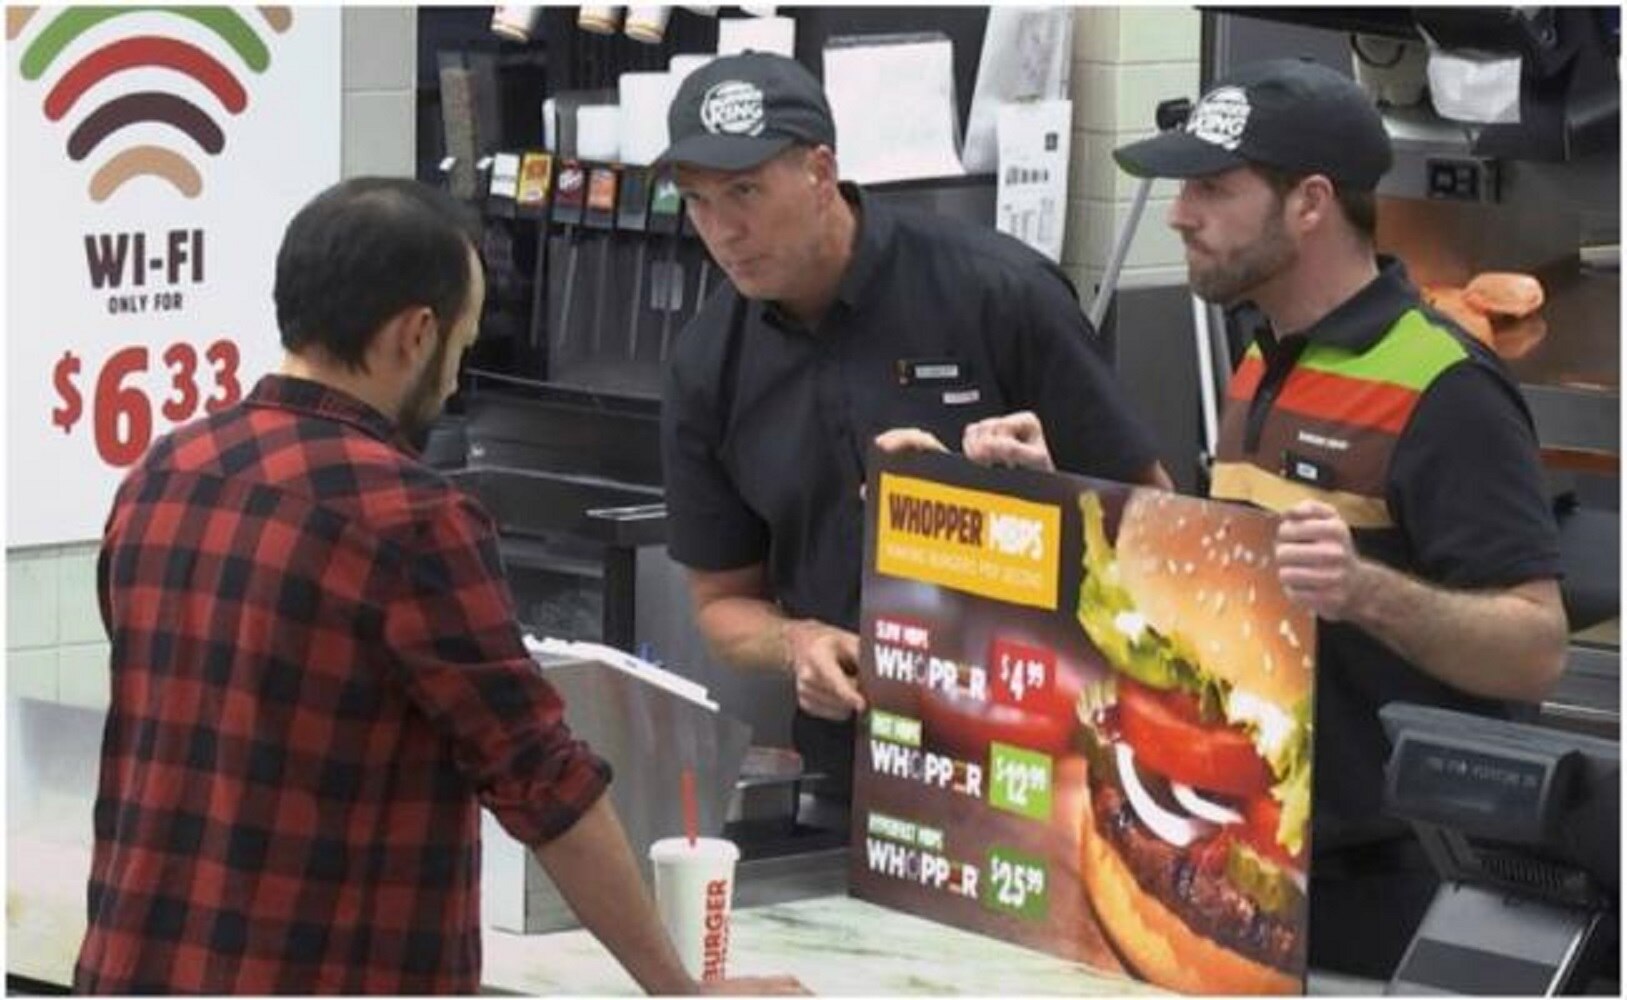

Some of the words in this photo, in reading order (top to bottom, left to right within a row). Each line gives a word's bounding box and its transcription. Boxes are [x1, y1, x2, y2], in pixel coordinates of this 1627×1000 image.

[84, 229, 203, 289] WI-FI
[108, 296, 147, 314] ONLY
[154, 292, 182, 310] FOR
[889, 493, 982, 546] WHOPPER
